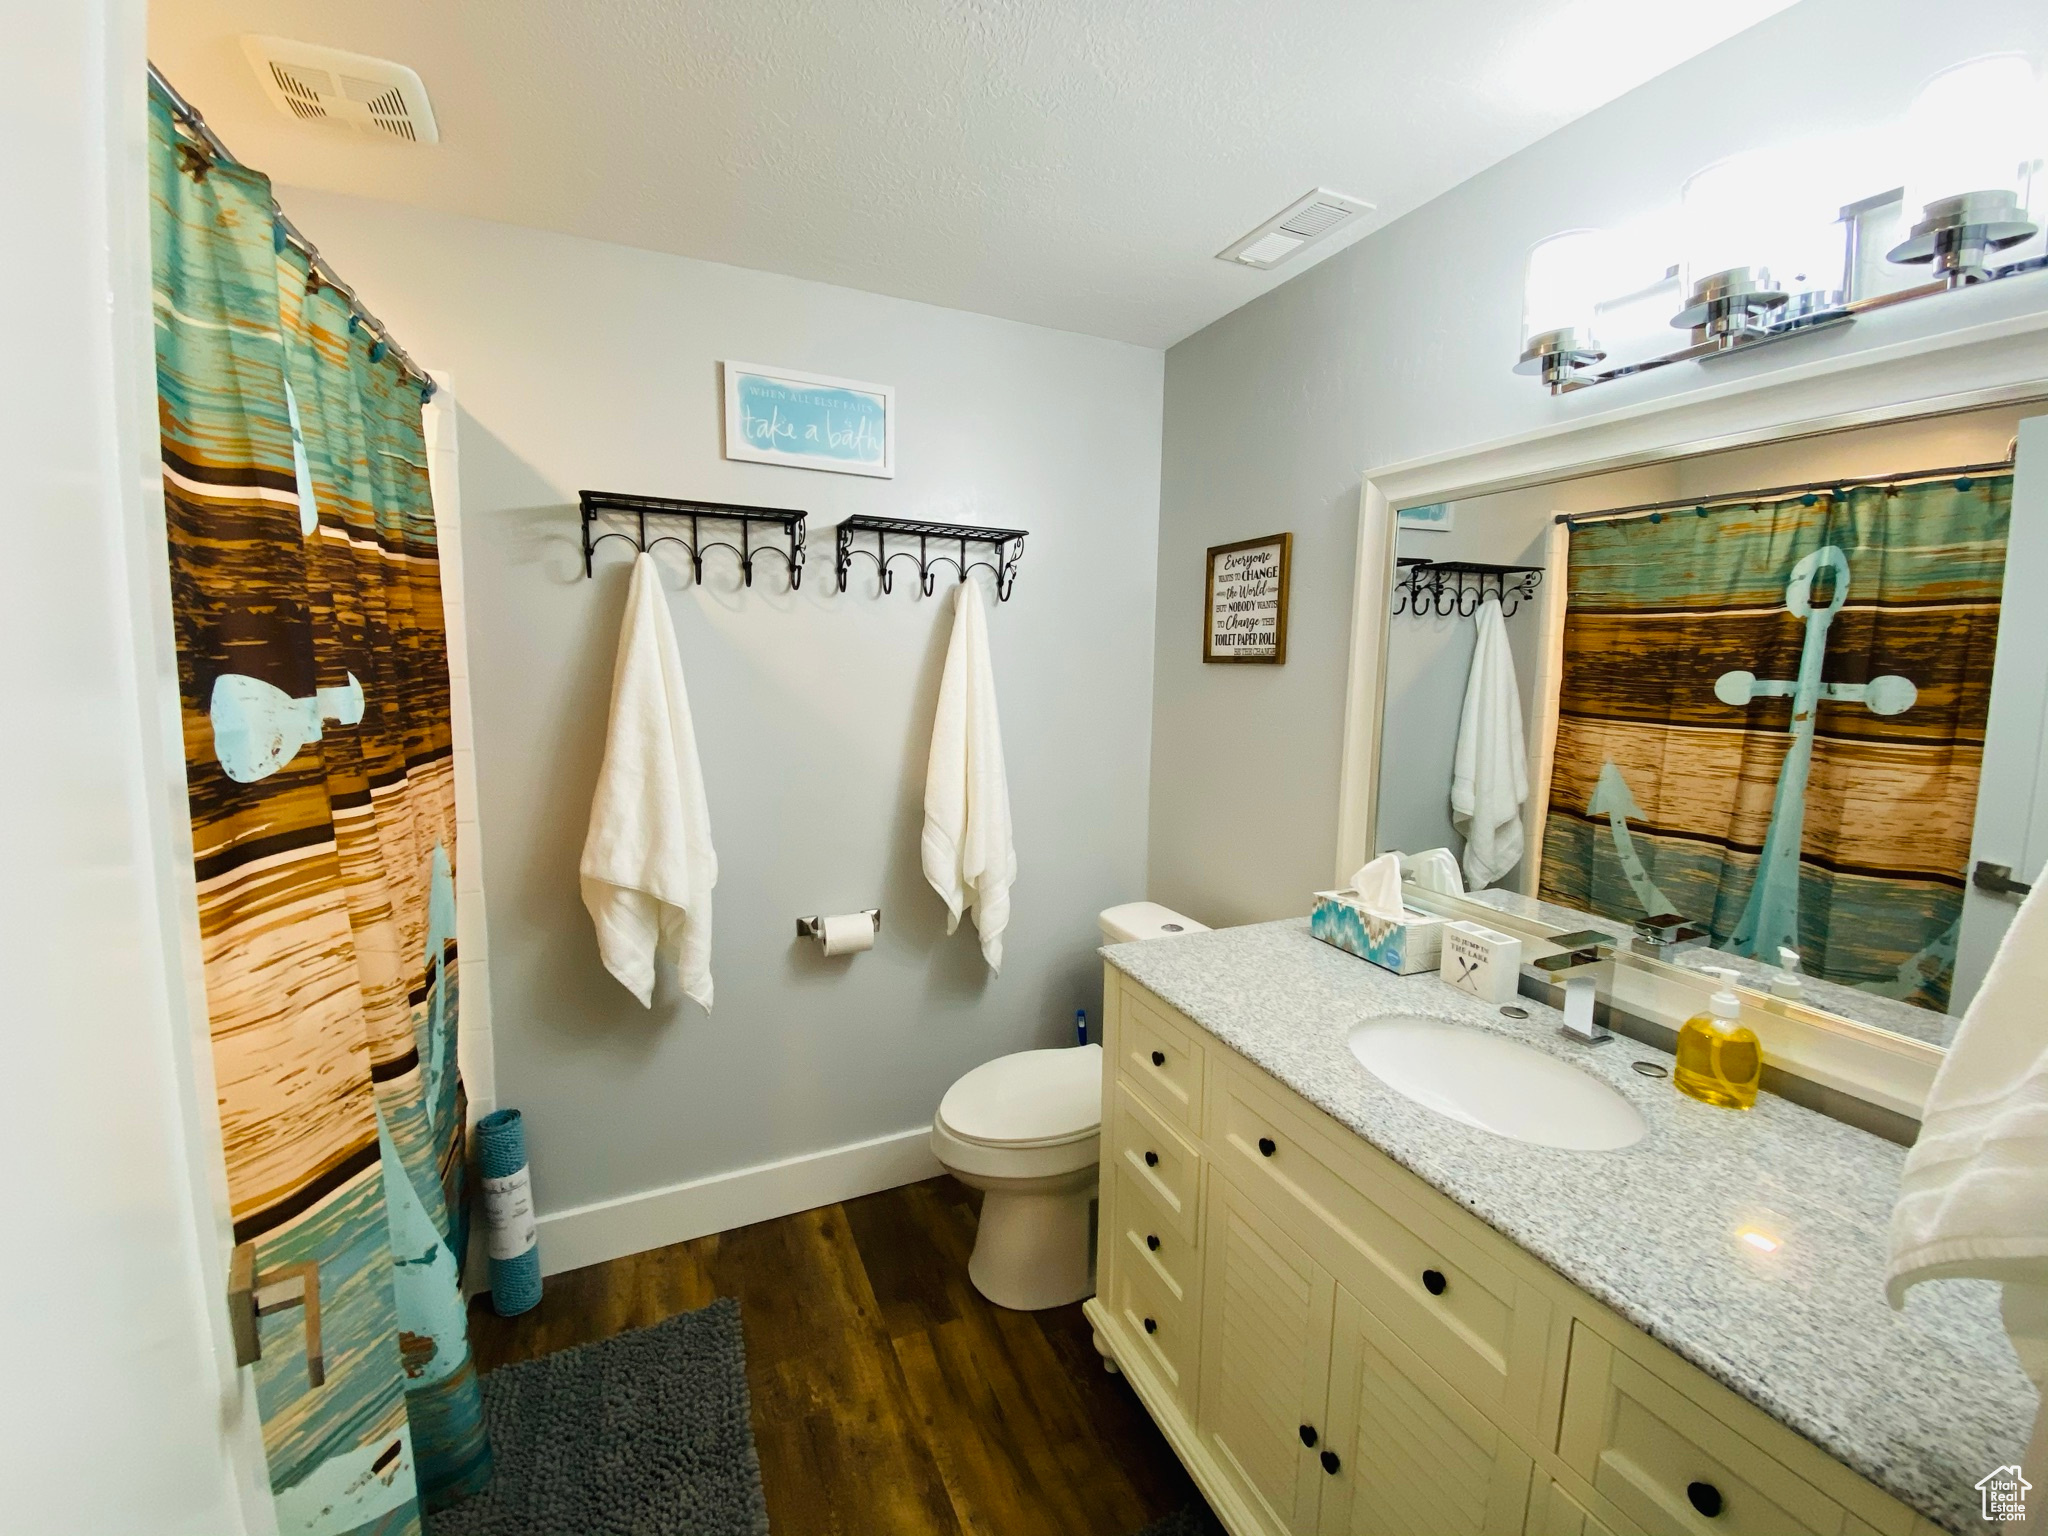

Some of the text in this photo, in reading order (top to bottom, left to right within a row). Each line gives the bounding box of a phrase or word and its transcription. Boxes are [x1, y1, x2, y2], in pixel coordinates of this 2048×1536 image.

[749, 387, 873, 413] WHEN ALL ELSE FAILS
[743, 404, 879, 461] take a bath
[1225, 552, 1272, 571] Everyone
[1241, 566, 1278, 581] CHANGE
[1226, 580, 1267, 600] the World
[1229, 600, 1256, 612] NOBODY
[1257, 599, 1278, 609] WANTS
[1225, 614, 1260, 632] Change
[1215, 632, 1276, 646] TOILET PAPER ROLL
[1451, 943, 1489, 963] THE LAKE
[1462, 939, 1480, 949] JUMP
